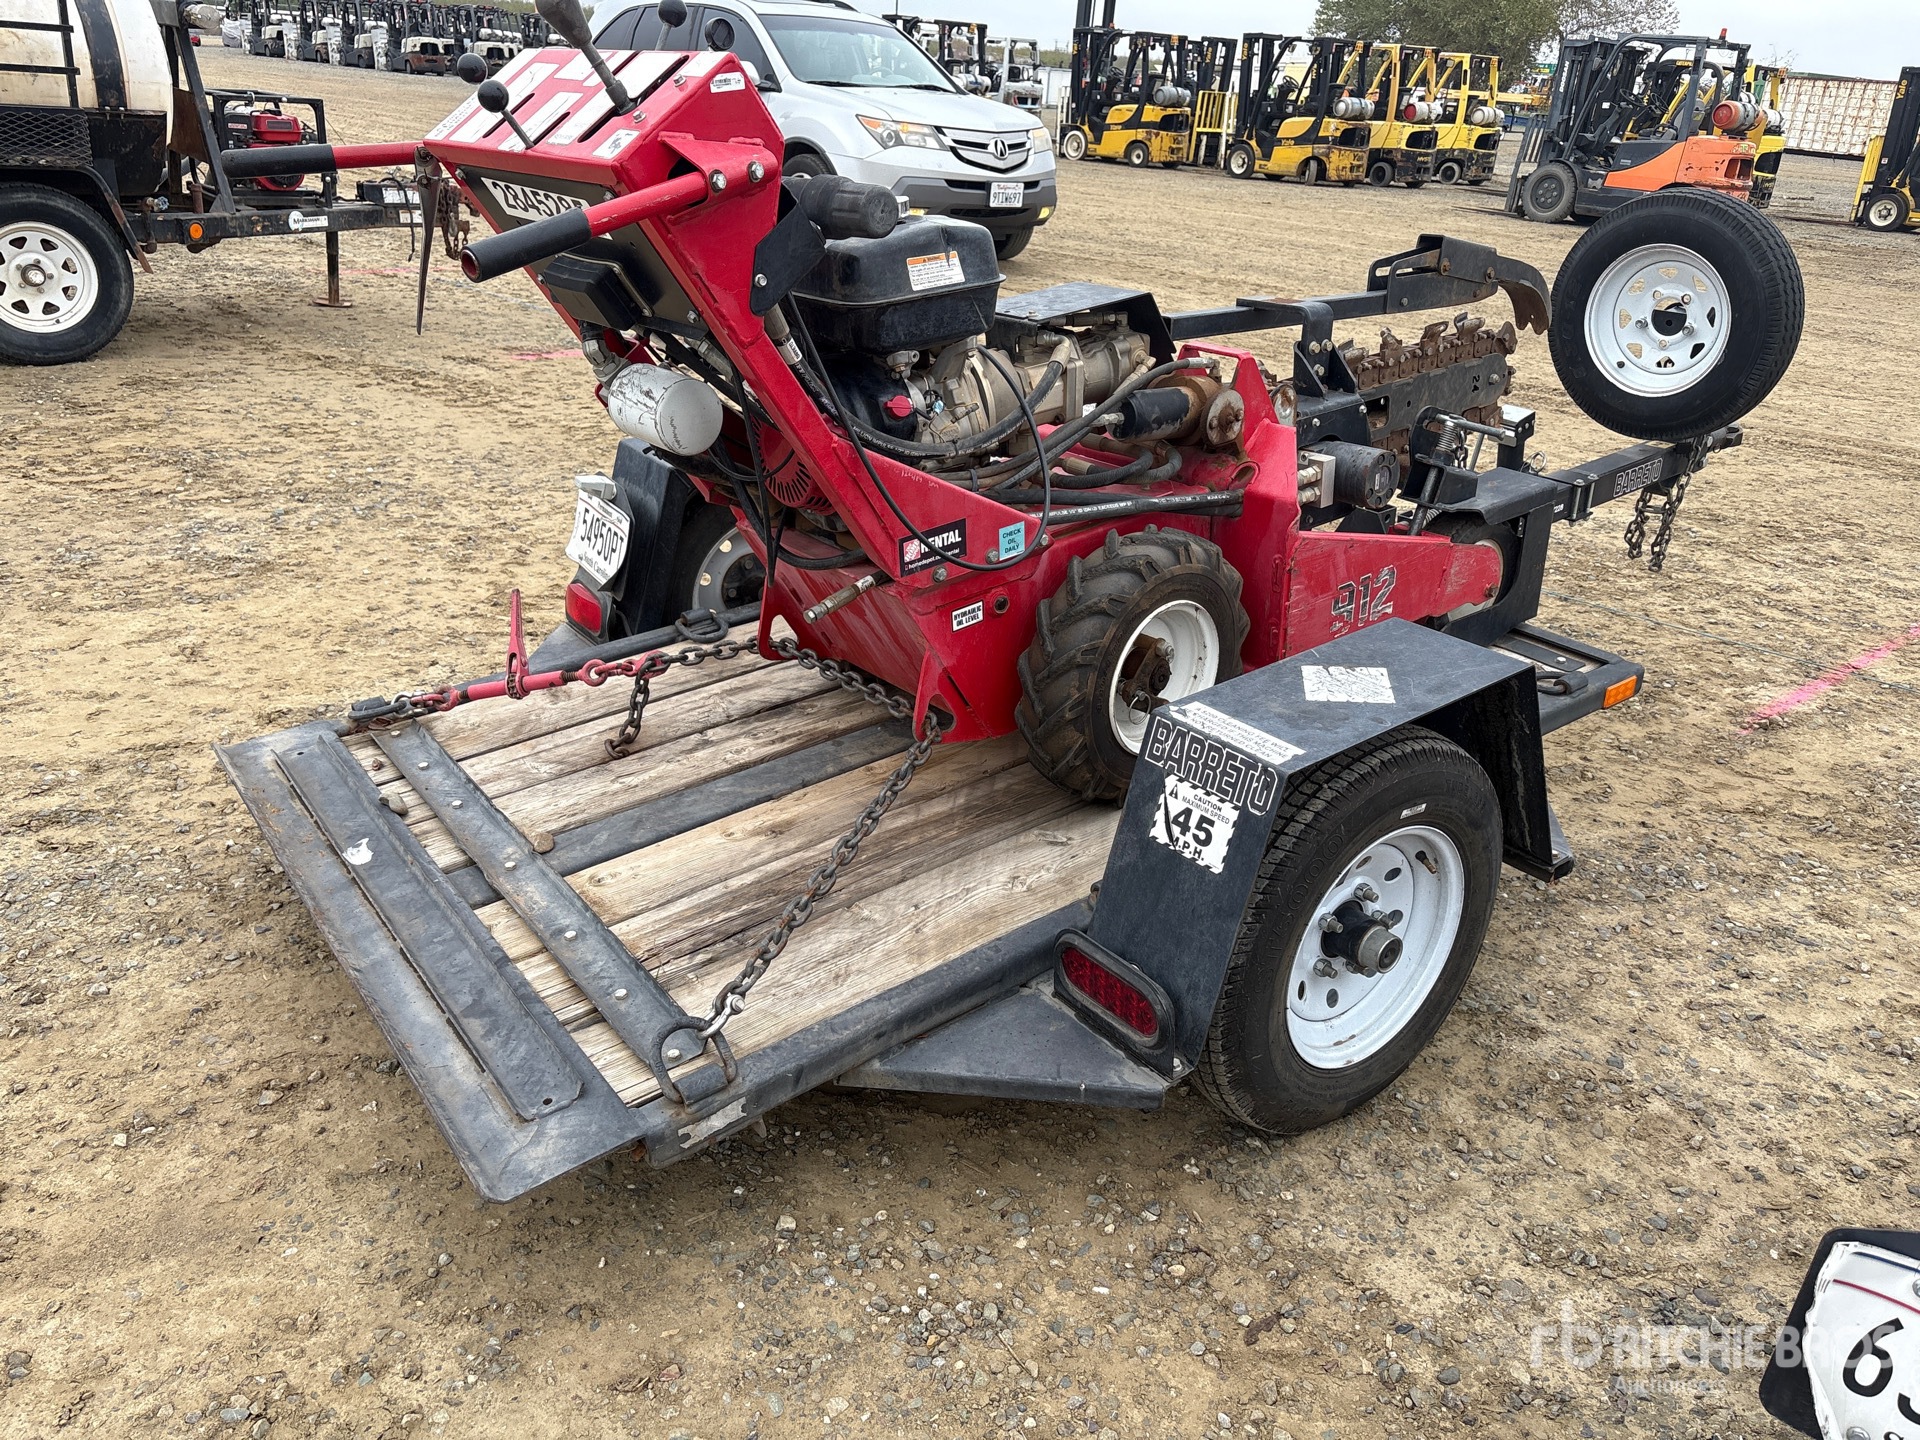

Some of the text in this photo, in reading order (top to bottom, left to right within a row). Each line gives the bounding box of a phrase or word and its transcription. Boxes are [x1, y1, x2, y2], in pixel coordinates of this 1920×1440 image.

[1896, 79, 1907, 100] Yale
[491, 181, 583, 217] 28452
[1613, 457, 1663, 497] BARRETO
[1002, 528, 1021, 539] CHECK
[908, 547, 960, 570] homedepot.corental
[1004, 544, 1020, 554] DAILY
[1330, 564, 1397, 632] 912
[953, 605, 982, 620] HYDRAULIC
[956, 614, 980, 627] OIL LEVEL
[1218, 717, 1256, 737] CLEANING
[1144, 715, 1279, 816] BARRETO
[1181, 795, 1230, 826] MAXIMUM SPEED
[1193, 793, 1223, 813] CAUTION
[1171, 806, 1216, 848] 45
[1171, 835, 1205, 862] M.P.H.
